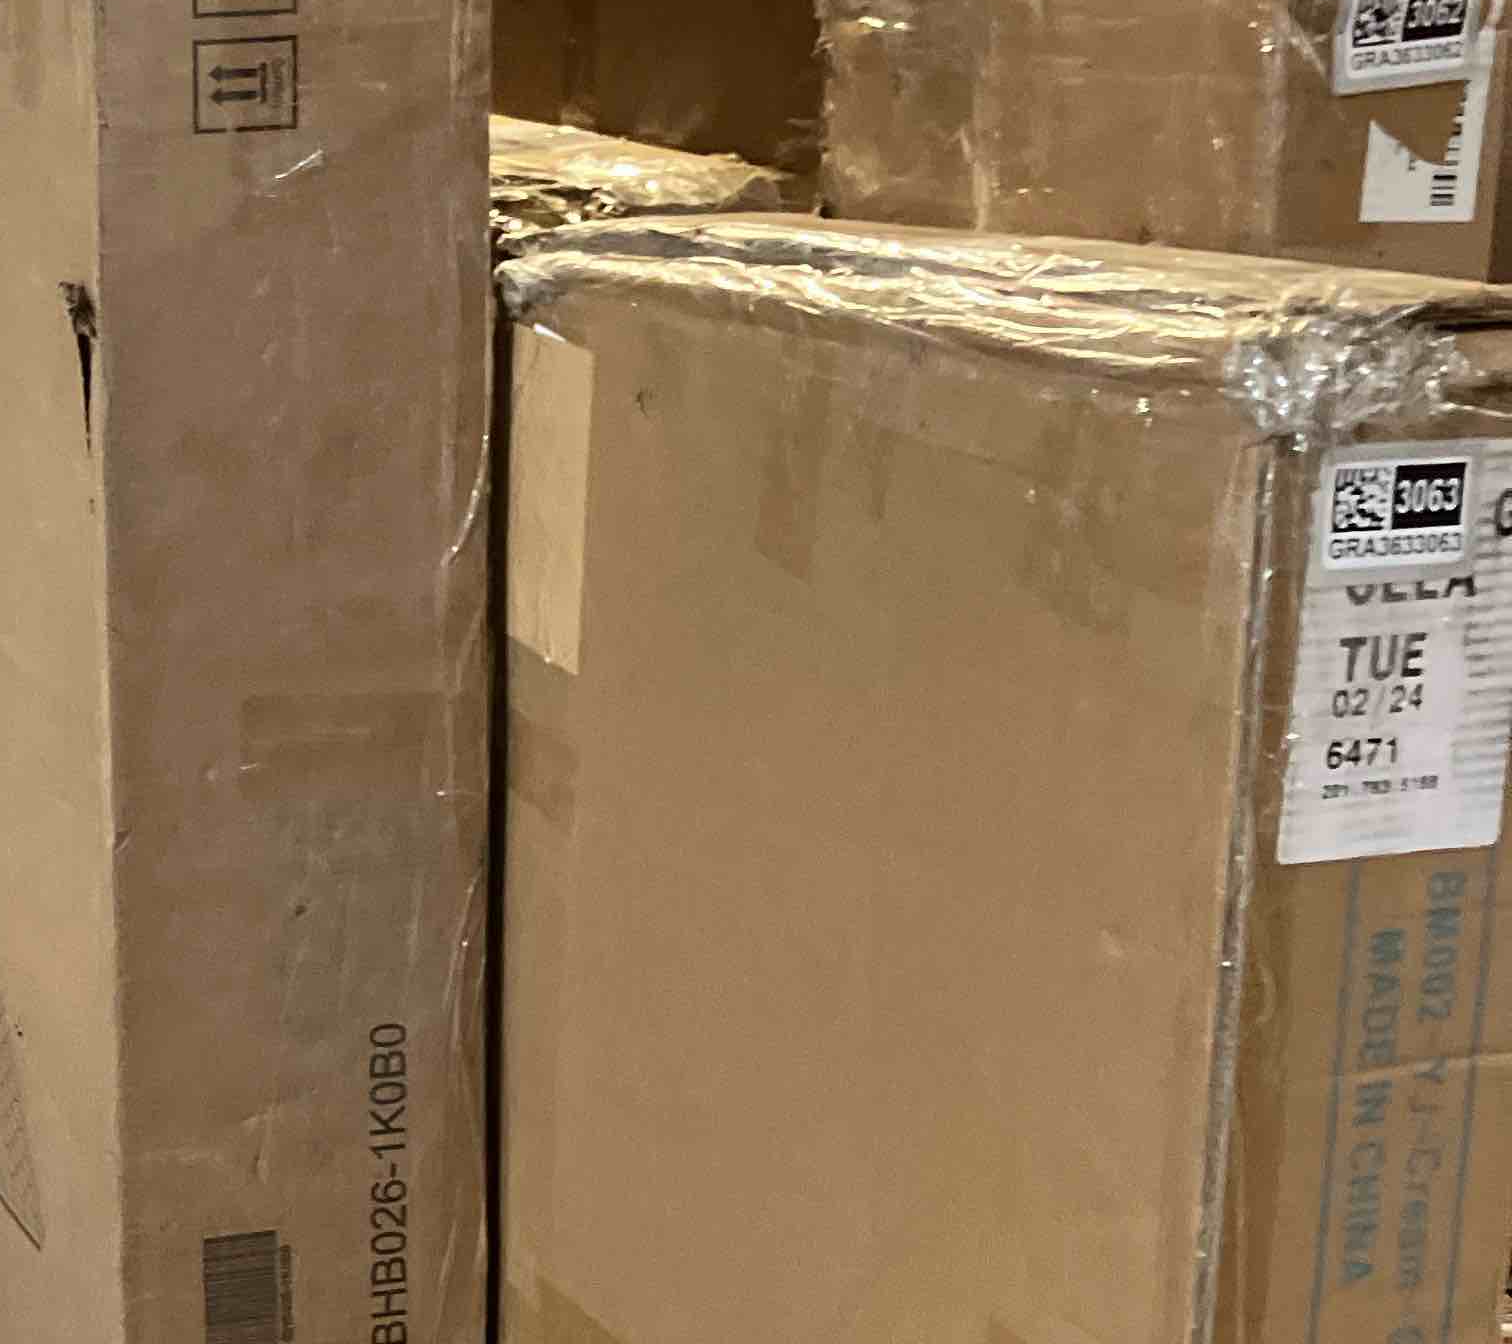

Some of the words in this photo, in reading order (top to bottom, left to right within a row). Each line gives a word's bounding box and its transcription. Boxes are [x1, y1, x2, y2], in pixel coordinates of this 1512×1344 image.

[1394, 476, 1462, 515] 3063
[1328, 531, 1462, 561] GRA3633063
[1339, 632, 1427, 683] TUE
[1330, 683, 1424, 719] 02/24
[1324, 737, 1399, 771] 6471
[1360, 928, 1406, 1066] MADE
[1351, 1079, 1392, 1129] IN
[1343, 1140, 1386, 1286] CHINA
